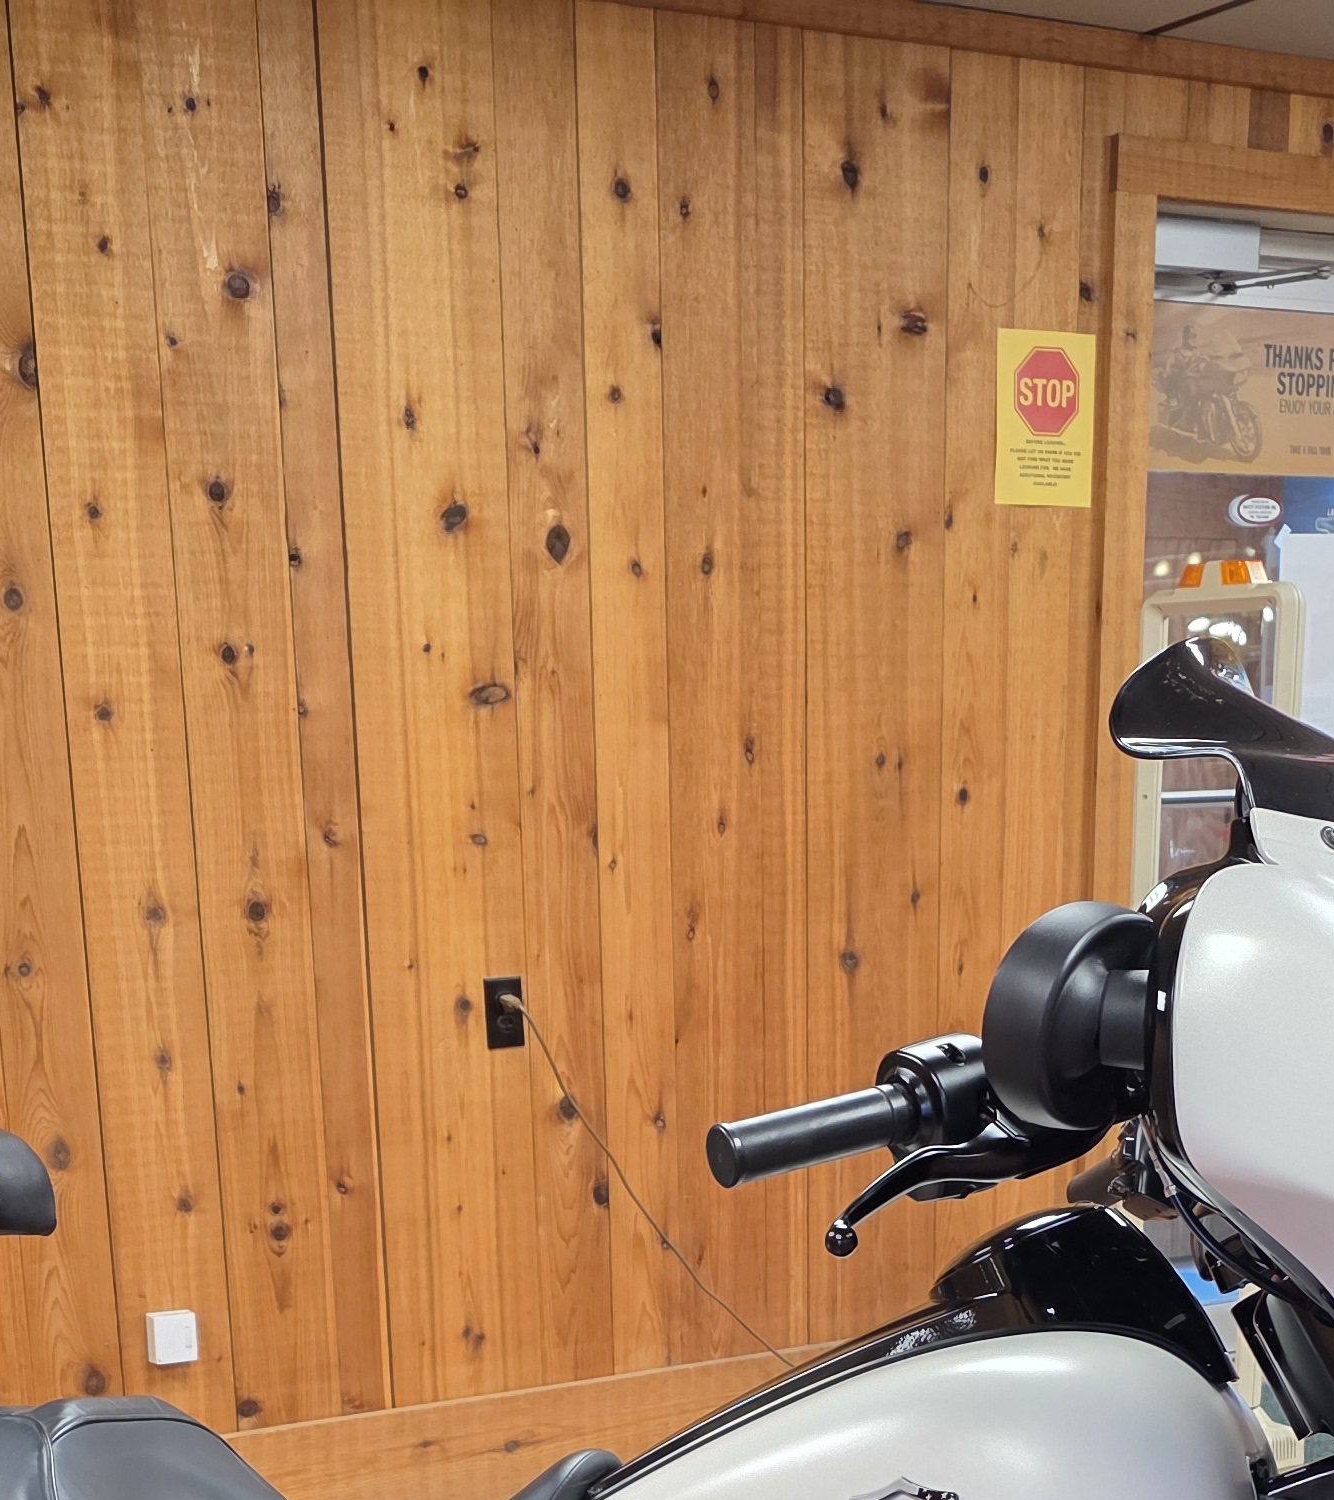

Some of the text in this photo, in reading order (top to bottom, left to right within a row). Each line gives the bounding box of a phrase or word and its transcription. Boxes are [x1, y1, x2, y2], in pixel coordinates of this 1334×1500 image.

[1264, 343, 1324, 371] THANKS
[1019, 377, 1075, 408] STOP
[1279, 399, 1306, 415] ENJOY
[1307, 400, 1331, 416] YOUR
